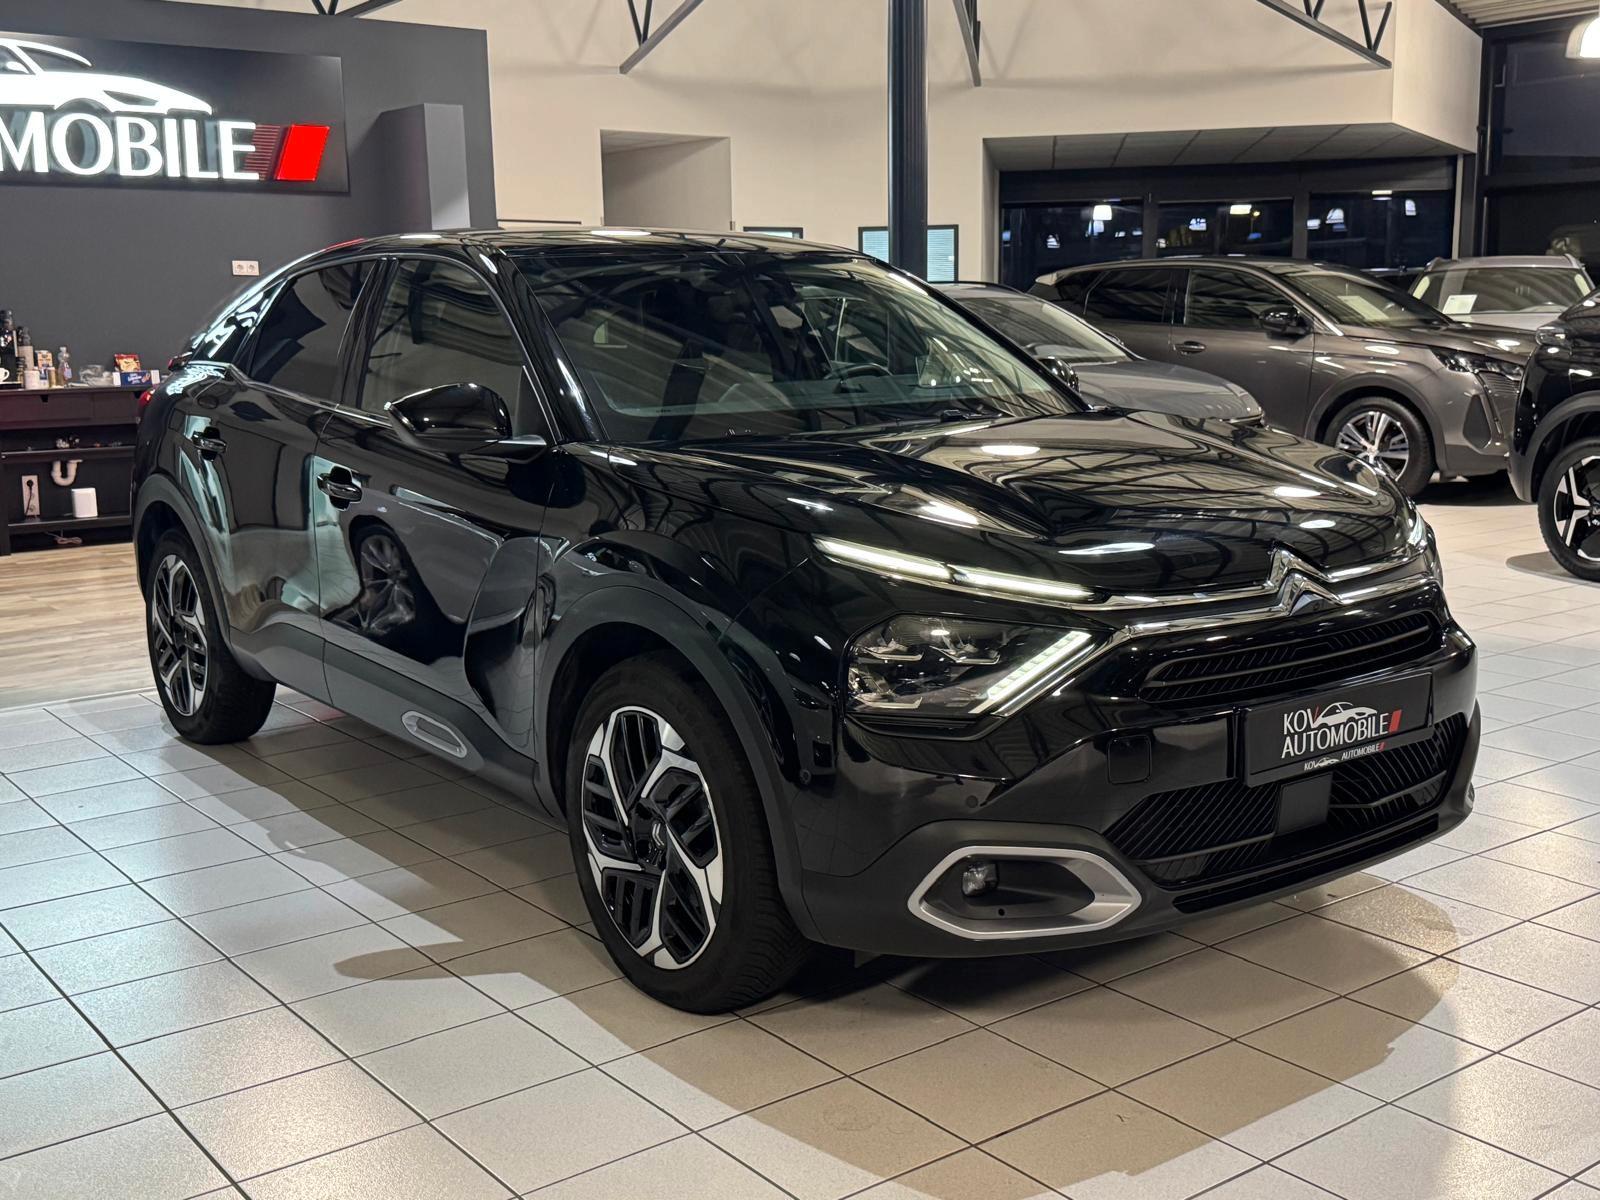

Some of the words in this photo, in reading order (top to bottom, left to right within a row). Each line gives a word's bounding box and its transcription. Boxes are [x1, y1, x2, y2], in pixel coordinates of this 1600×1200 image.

[0, 111, 260, 181] MOBILE
[1281, 712, 1390, 759] AUTOMOBILE
[1283, 706, 1320, 735] KOV
[1303, 760, 1320, 771] KOV
[1341, 743, 1380, 761] AUTOMOBILE
